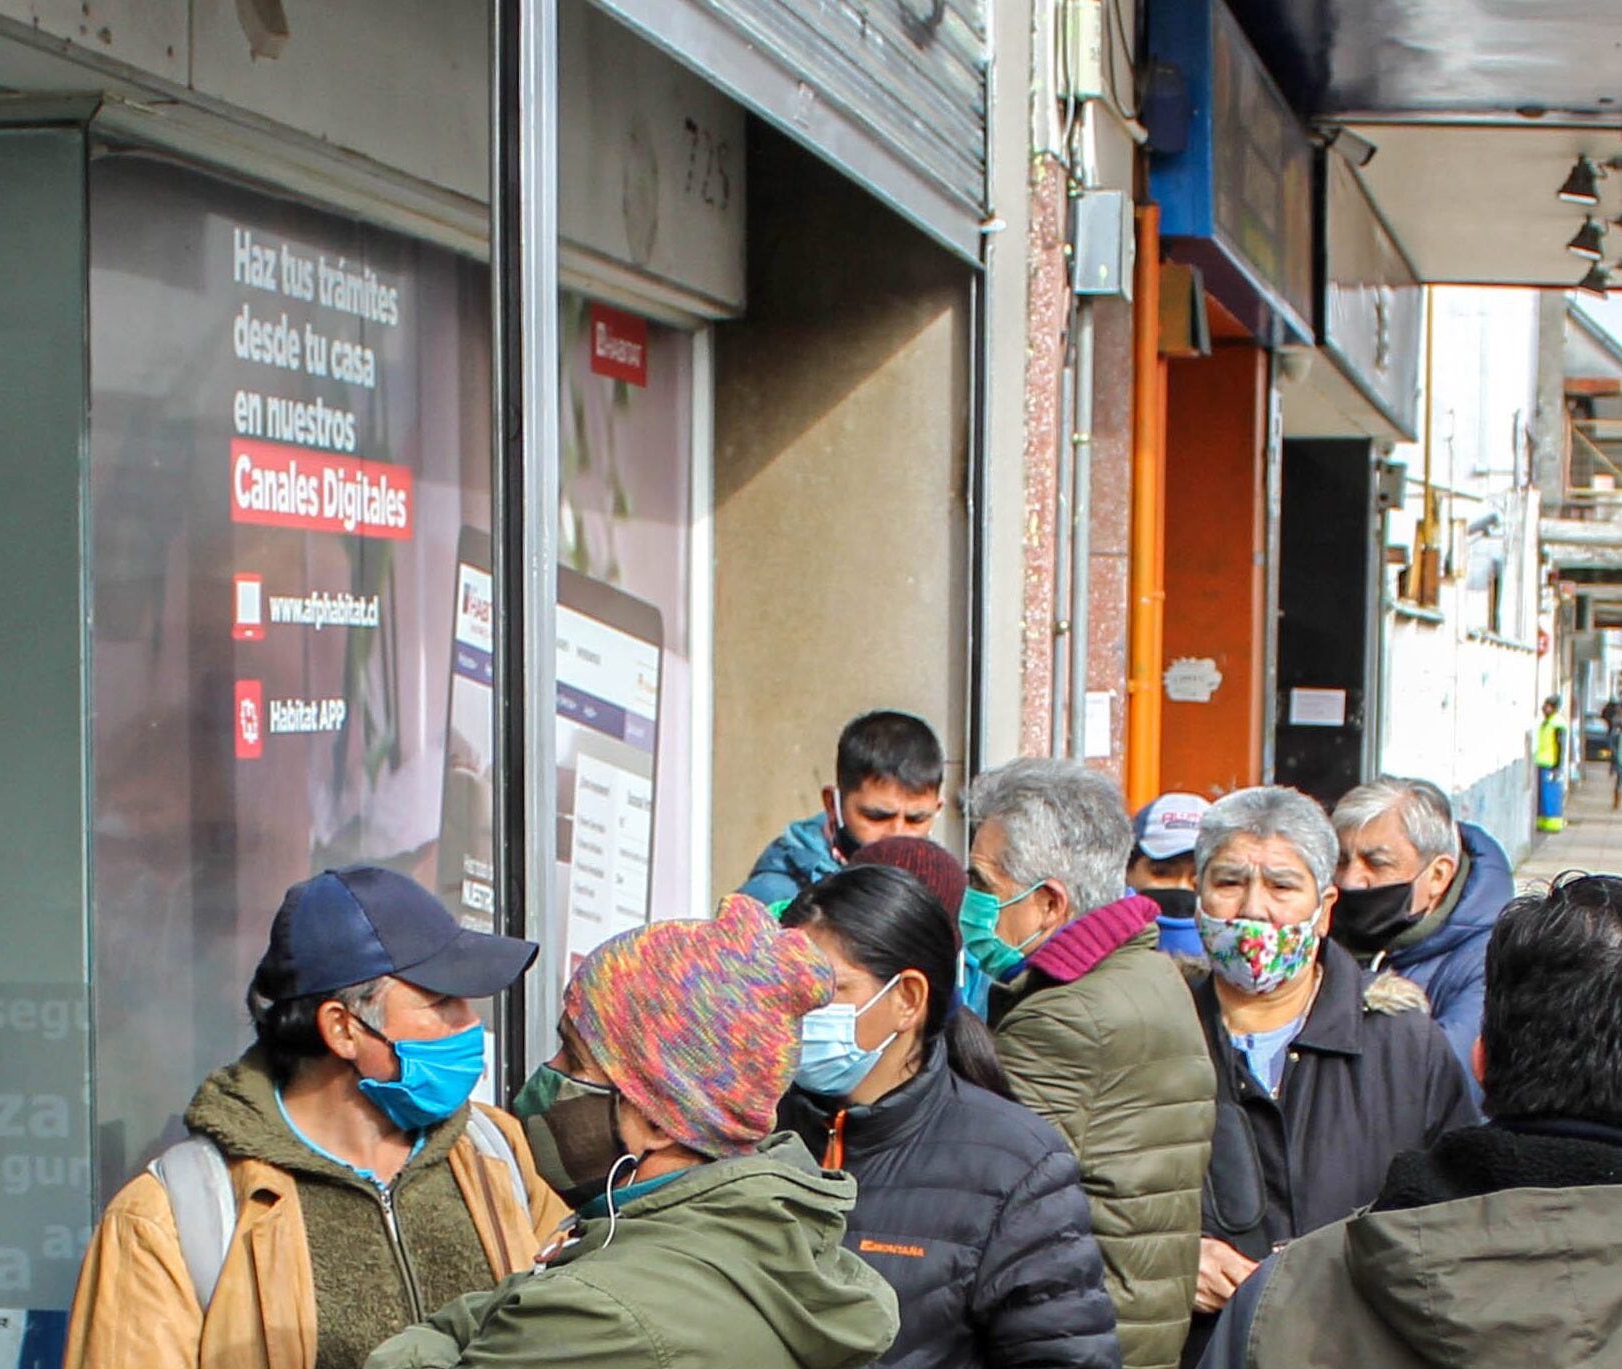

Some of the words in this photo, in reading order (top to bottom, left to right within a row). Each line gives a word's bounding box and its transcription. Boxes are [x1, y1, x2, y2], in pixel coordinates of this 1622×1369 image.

[233, 227, 276, 292] Haz
[281, 244, 315, 302] tus
[319, 256, 399, 327] trámites
[233, 303, 300, 371] desde
[304, 323, 327, 377] tu
[330, 338, 376, 388] casa
[233, 390, 261, 436] en
[267, 396, 357, 453] nuestros
[234, 454, 320, 518] Canales
[323, 467, 407, 532] Digitales
[270, 699, 318, 733] Habitat
[319, 698, 347, 732] APP
